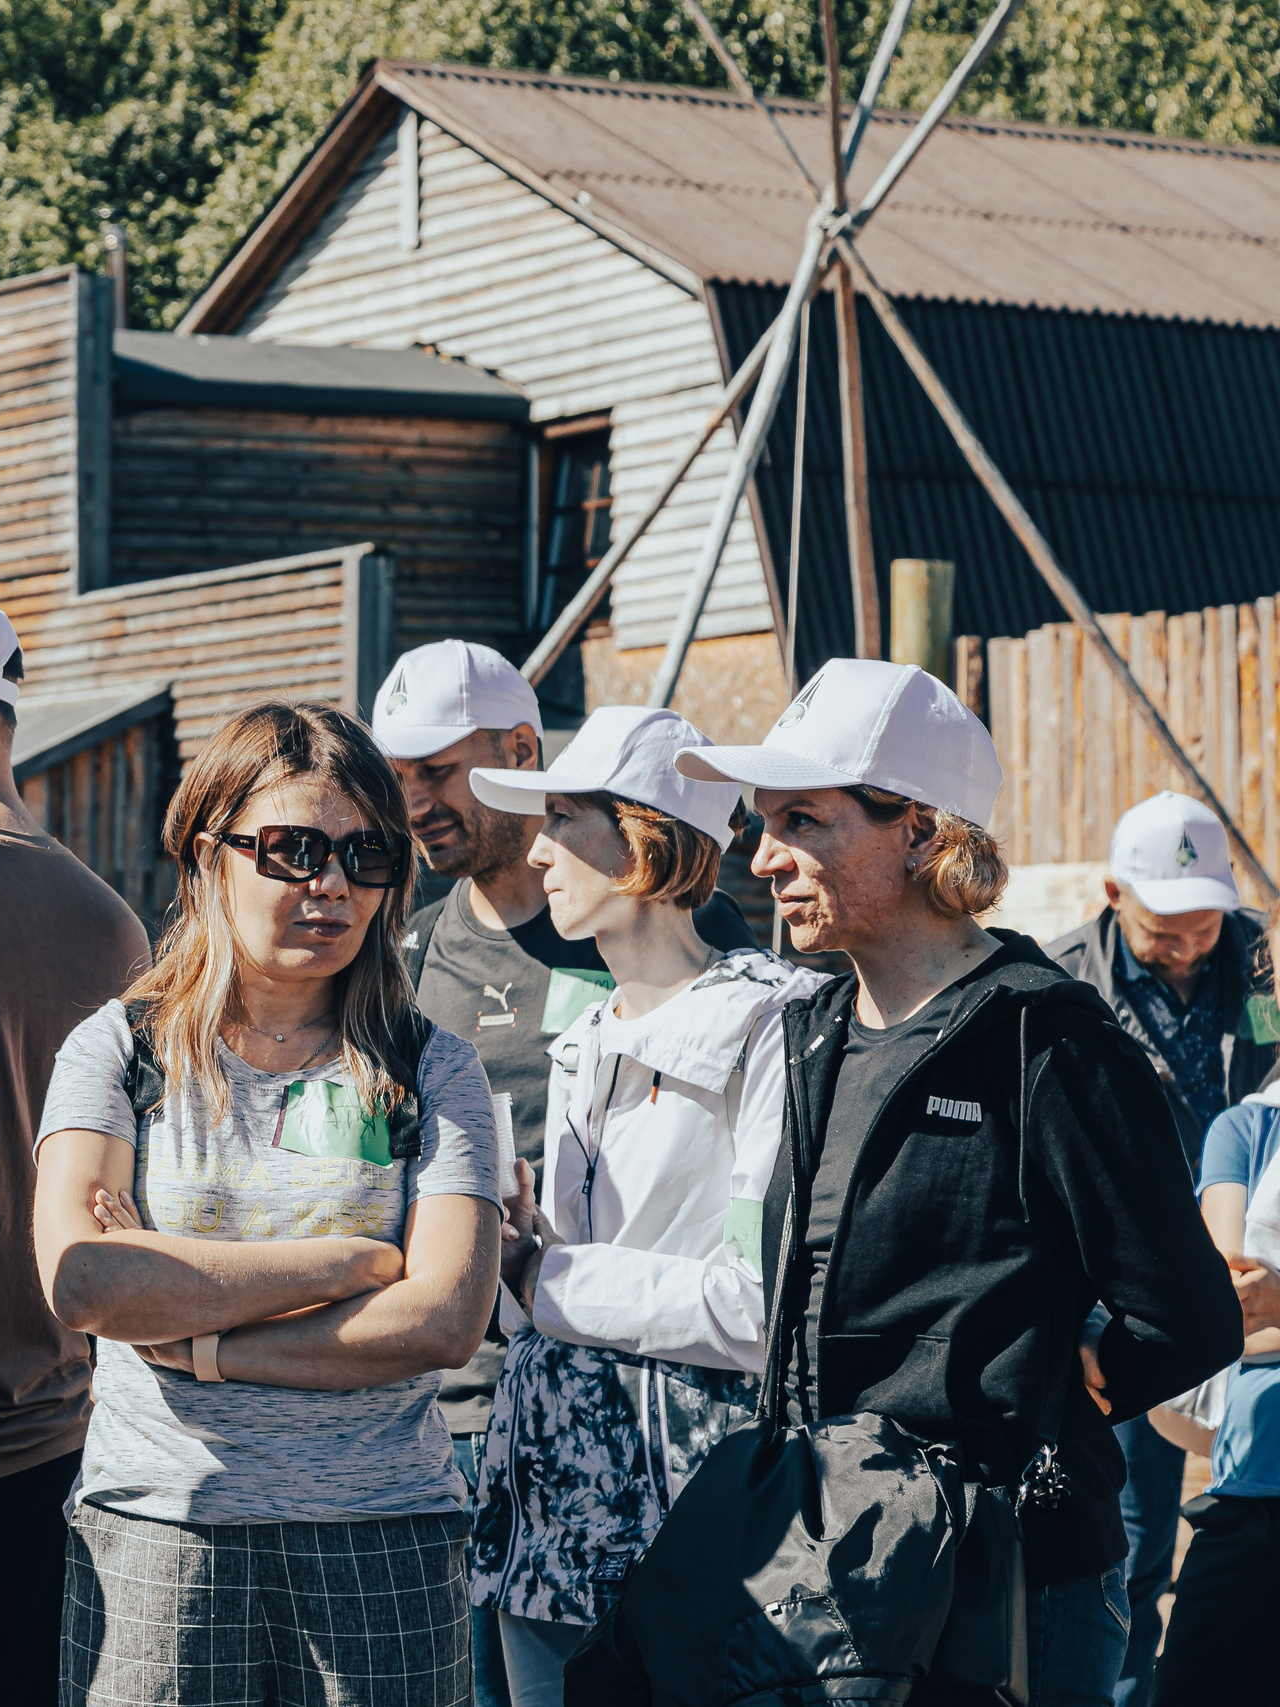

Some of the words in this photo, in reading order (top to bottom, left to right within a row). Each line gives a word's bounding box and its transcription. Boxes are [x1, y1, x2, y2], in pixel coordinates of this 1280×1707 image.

[926, 1095, 982, 1122] PUMA
[137, 1144, 274, 1189] KARMA
[291, 1158, 399, 1189] SEND
[139, 1190, 225, 1233] YOU
[240, 1202, 274, 1236] A
[291, 1201, 384, 1236] KISS
